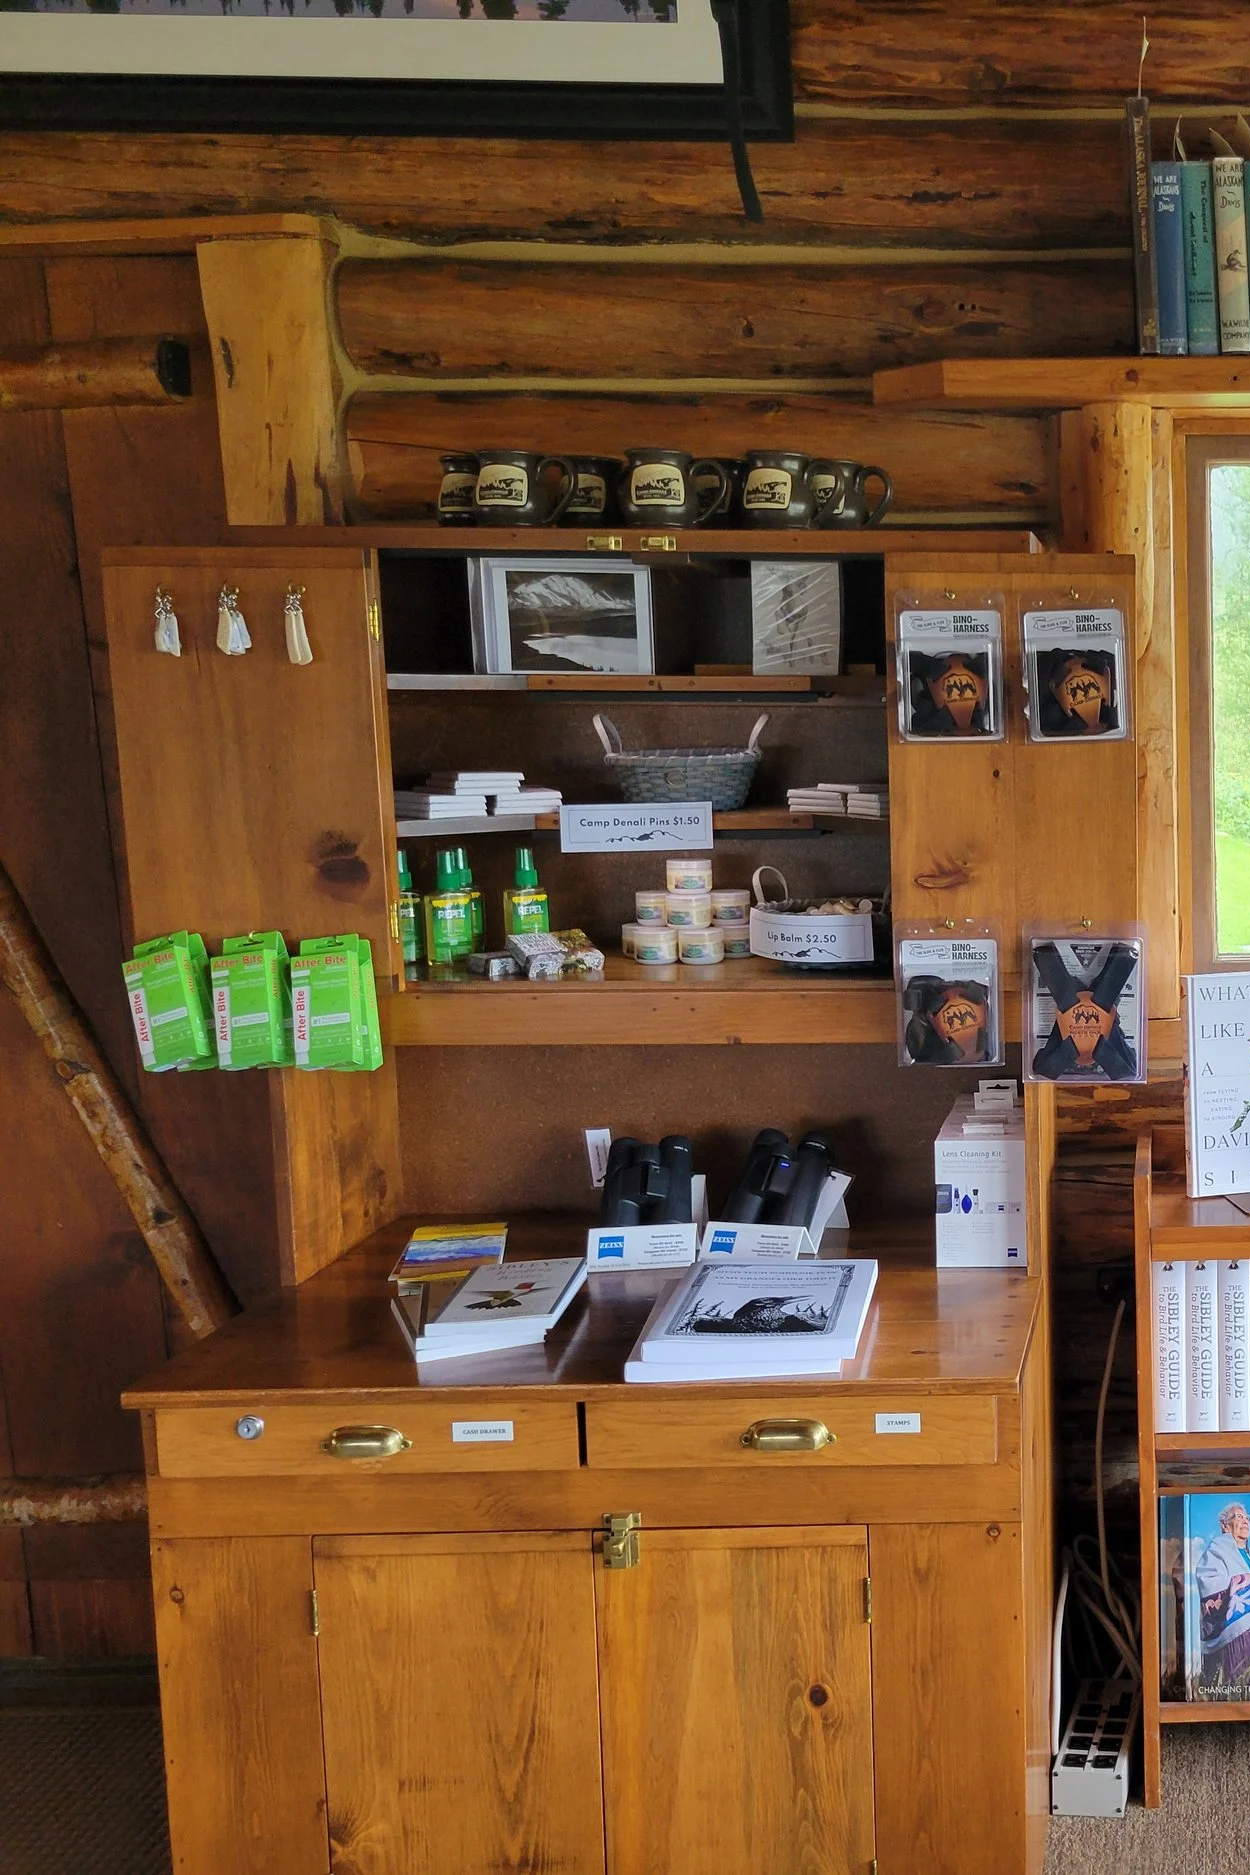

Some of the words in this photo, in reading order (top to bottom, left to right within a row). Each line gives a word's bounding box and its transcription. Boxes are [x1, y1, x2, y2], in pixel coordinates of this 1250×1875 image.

[1166, 175, 1178, 184] ARE
[1153, 185, 1180, 197] ALASKANS
[952, 615, 978, 624] BINO-
[1075, 614, 1100, 624] BINO-
[1075, 623, 1112, 633] HARNESS
[952, 624, 990, 633] HARNESS
[579, 818, 610, 829] Camp
[613, 817, 646, 827] Denali
[649, 817, 670, 827] Pins
[673, 815, 700, 826] $1.50
[767, 931, 779, 942] Lip
[780, 932, 803, 943] Balm
[805, 934, 837, 944] $2.50
[952, 943, 976, 952] BINO-
[952, 952, 988, 960] HARNESS
[125, 960, 150, 973] After
[153, 952, 175, 964] Bite
[294, 959, 320, 968] After
[133, 993, 144, 1014] Bite
[217, 991, 226, 1012] Bite
[296, 990, 305, 1011] Bite
[139, 1017, 150, 1042] After
[219, 1016, 229, 1041] After
[297, 1015, 307, 1041] After
[1200, 1022, 1245, 1039] LIKE
[1201, 1062, 1215, 1077] A
[942, 1150, 958, 1158] Lens
[960, 1150, 990, 1159] Cleaning
[991, 1150, 1002, 1158] Kit
[600, 1241, 624, 1249] ZEISS
[713, 1236, 736, 1244] ZEISS
[1159, 1294, 1166, 1303] to
[1224, 1292, 1231, 1302] to
[1159, 1305, 1167, 1324] Bird
[1167, 1293, 1180, 1345] SIBLEY
[1192, 1305, 1200, 1323] Bird
[1200, 1292, 1212, 1344] SIBLEY
[1225, 1304, 1233, 1323] Bird
[1233, 1291, 1245, 1343] SIBLEY
[1159, 1326, 1168, 1345] Life
[1192, 1326, 1200, 1344] Life
[1225, 1325, 1233, 1343] Life
[1159, 1357, 1168, 1399] Behavior
[1168, 1349, 1181, 1400] GUIDE
[1192, 1355, 1200, 1397] Behavior
[1200, 1349, 1213, 1399] GUIDE
[1225, 1354, 1233, 1396] Behavior
[1233, 1348, 1246, 1399] GUIDE
[1198, 1685, 1242, 1694] CHANGING
